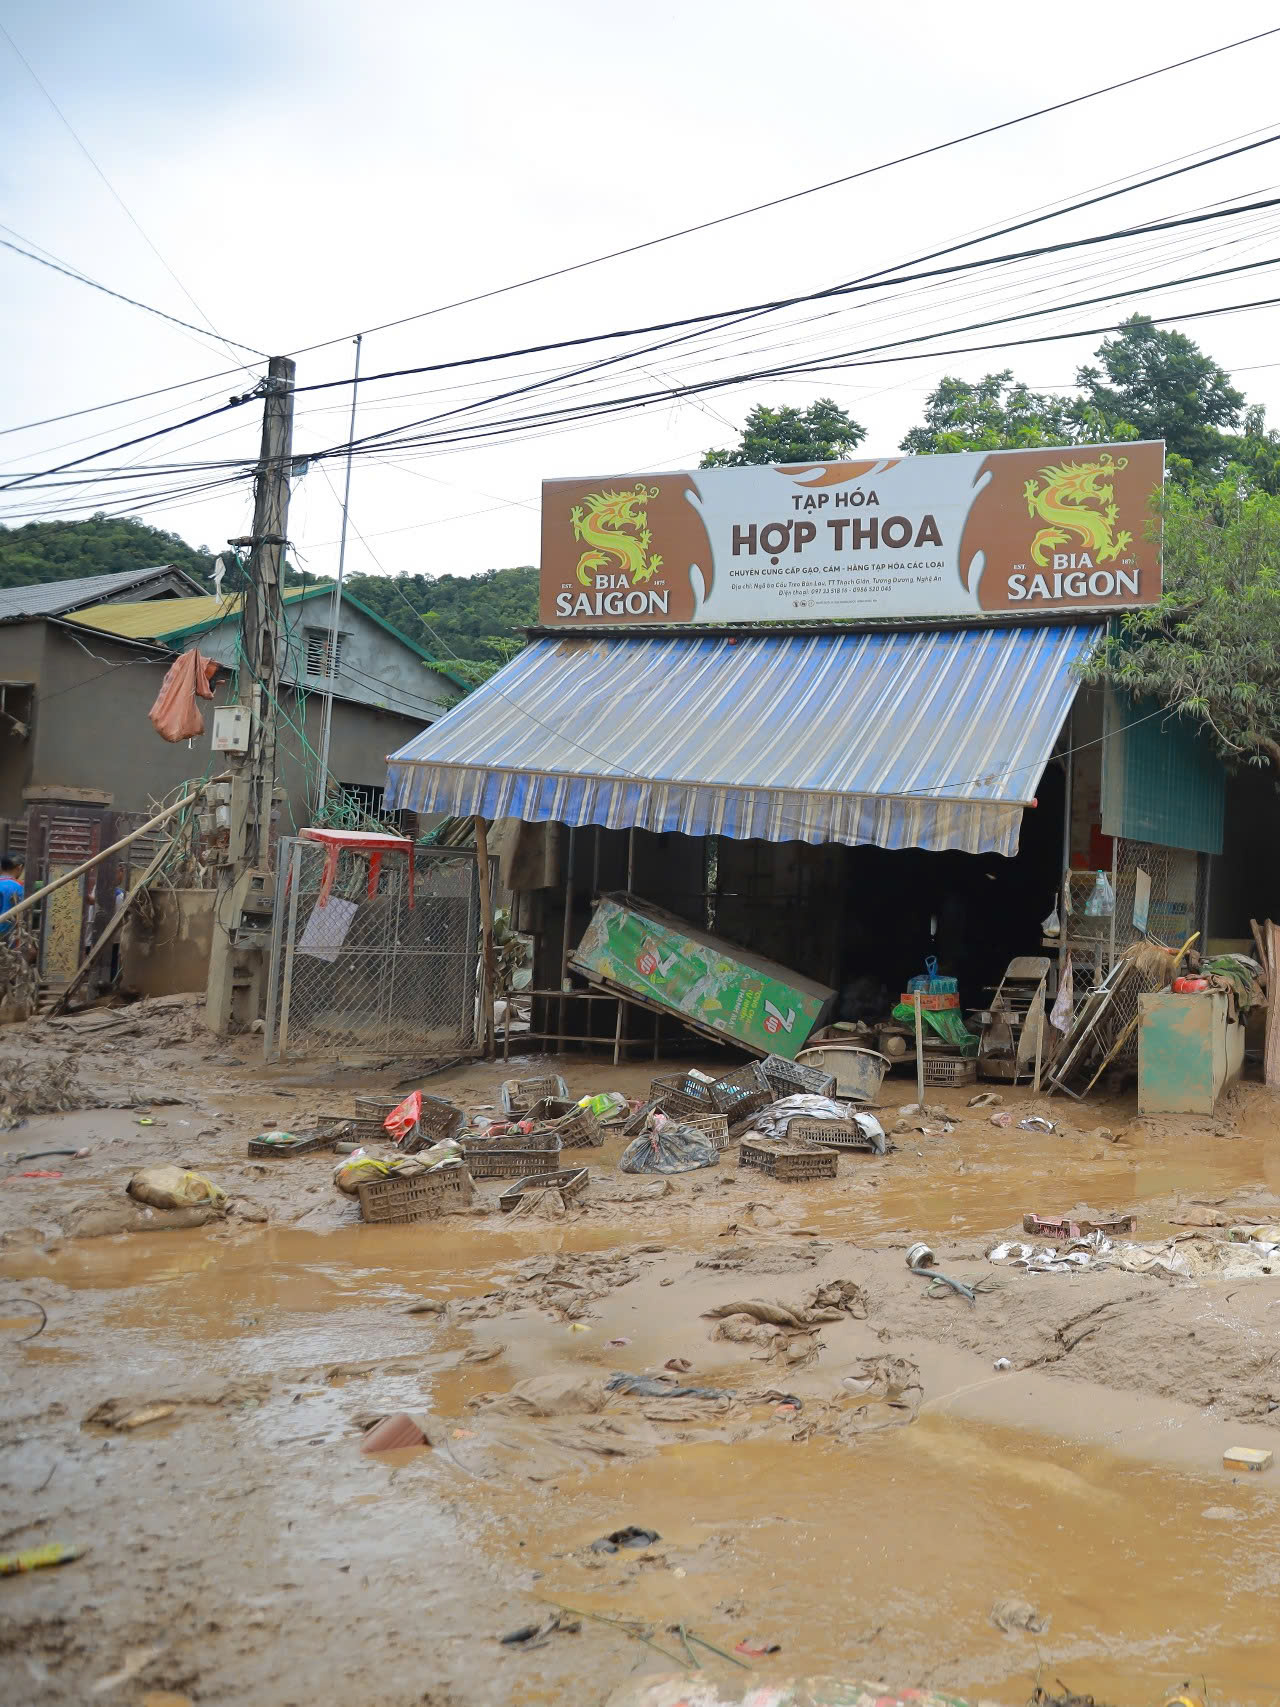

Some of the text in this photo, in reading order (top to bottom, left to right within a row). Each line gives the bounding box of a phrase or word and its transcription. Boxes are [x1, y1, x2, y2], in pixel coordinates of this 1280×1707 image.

[792, 487, 880, 514] TẠP HÓA
[732, 514, 943, 566] HỢP THOA
[729, 567, 760, 577] CHUYÊN
[761, 567, 783, 576] CUNG
[784, 565, 800, 575] CẤP
[802, 566, 821, 577] GẠO,
[847, 563, 870, 572] HÀNG
[871, 563, 886, 573] TẠP
[887, 561, 906, 570] HÓA
[907, 561, 924, 569] CÁC
[925, 561, 945, 570] LOẠI
[1053, 552, 1093, 570] BIA
[595, 574, 630, 590] BIA
[1007, 568, 1140, 600] SAIGON
[556, 590, 670, 617] SAIGON
